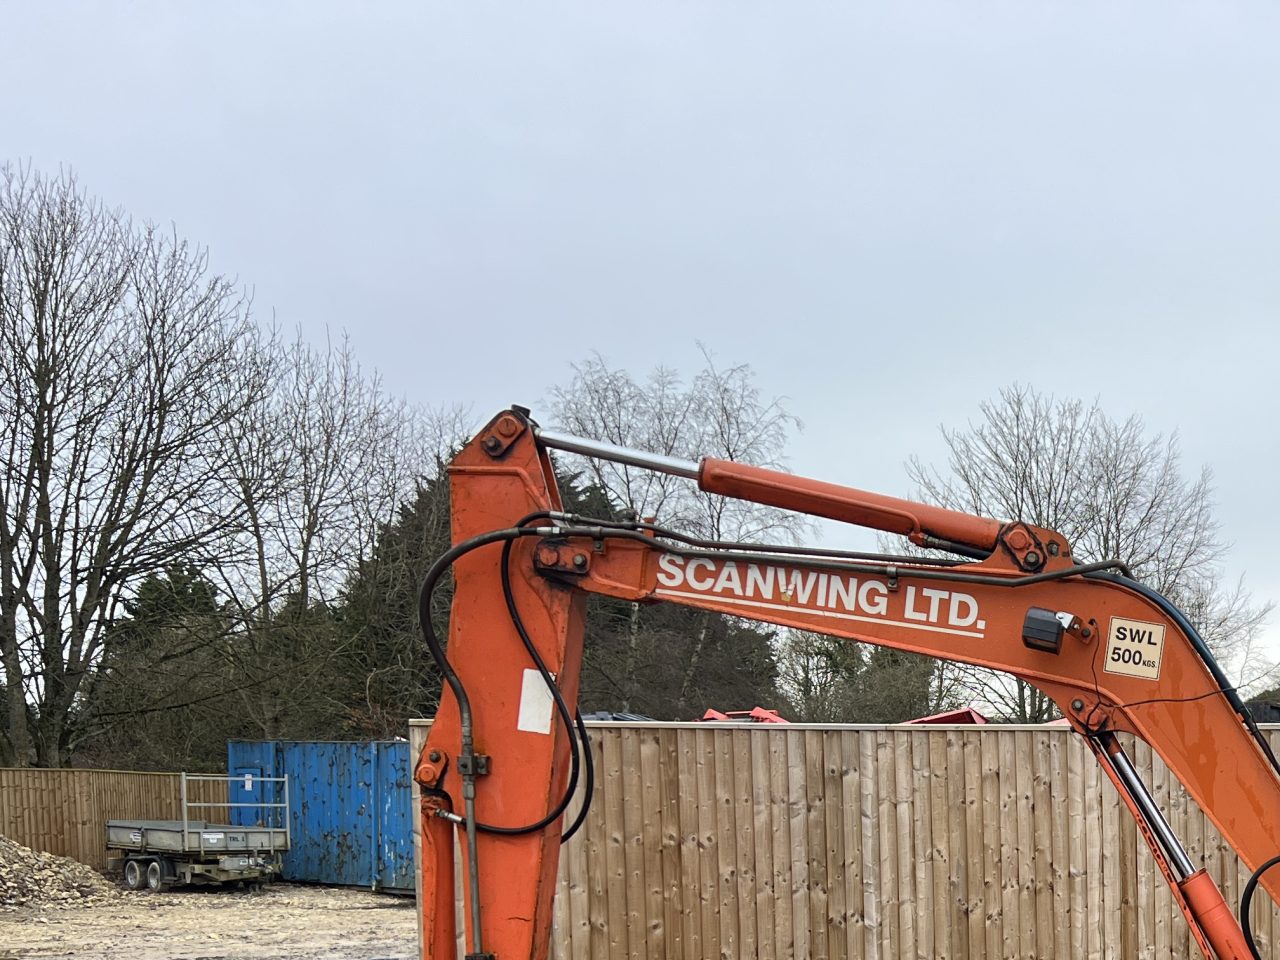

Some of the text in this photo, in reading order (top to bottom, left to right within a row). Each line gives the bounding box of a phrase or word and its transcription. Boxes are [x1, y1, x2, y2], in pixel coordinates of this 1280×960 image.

[656, 554, 986, 630] SCANWING LTD.
[1115, 626, 1157, 646] SWL
[1111, 647, 1142, 665] 500
